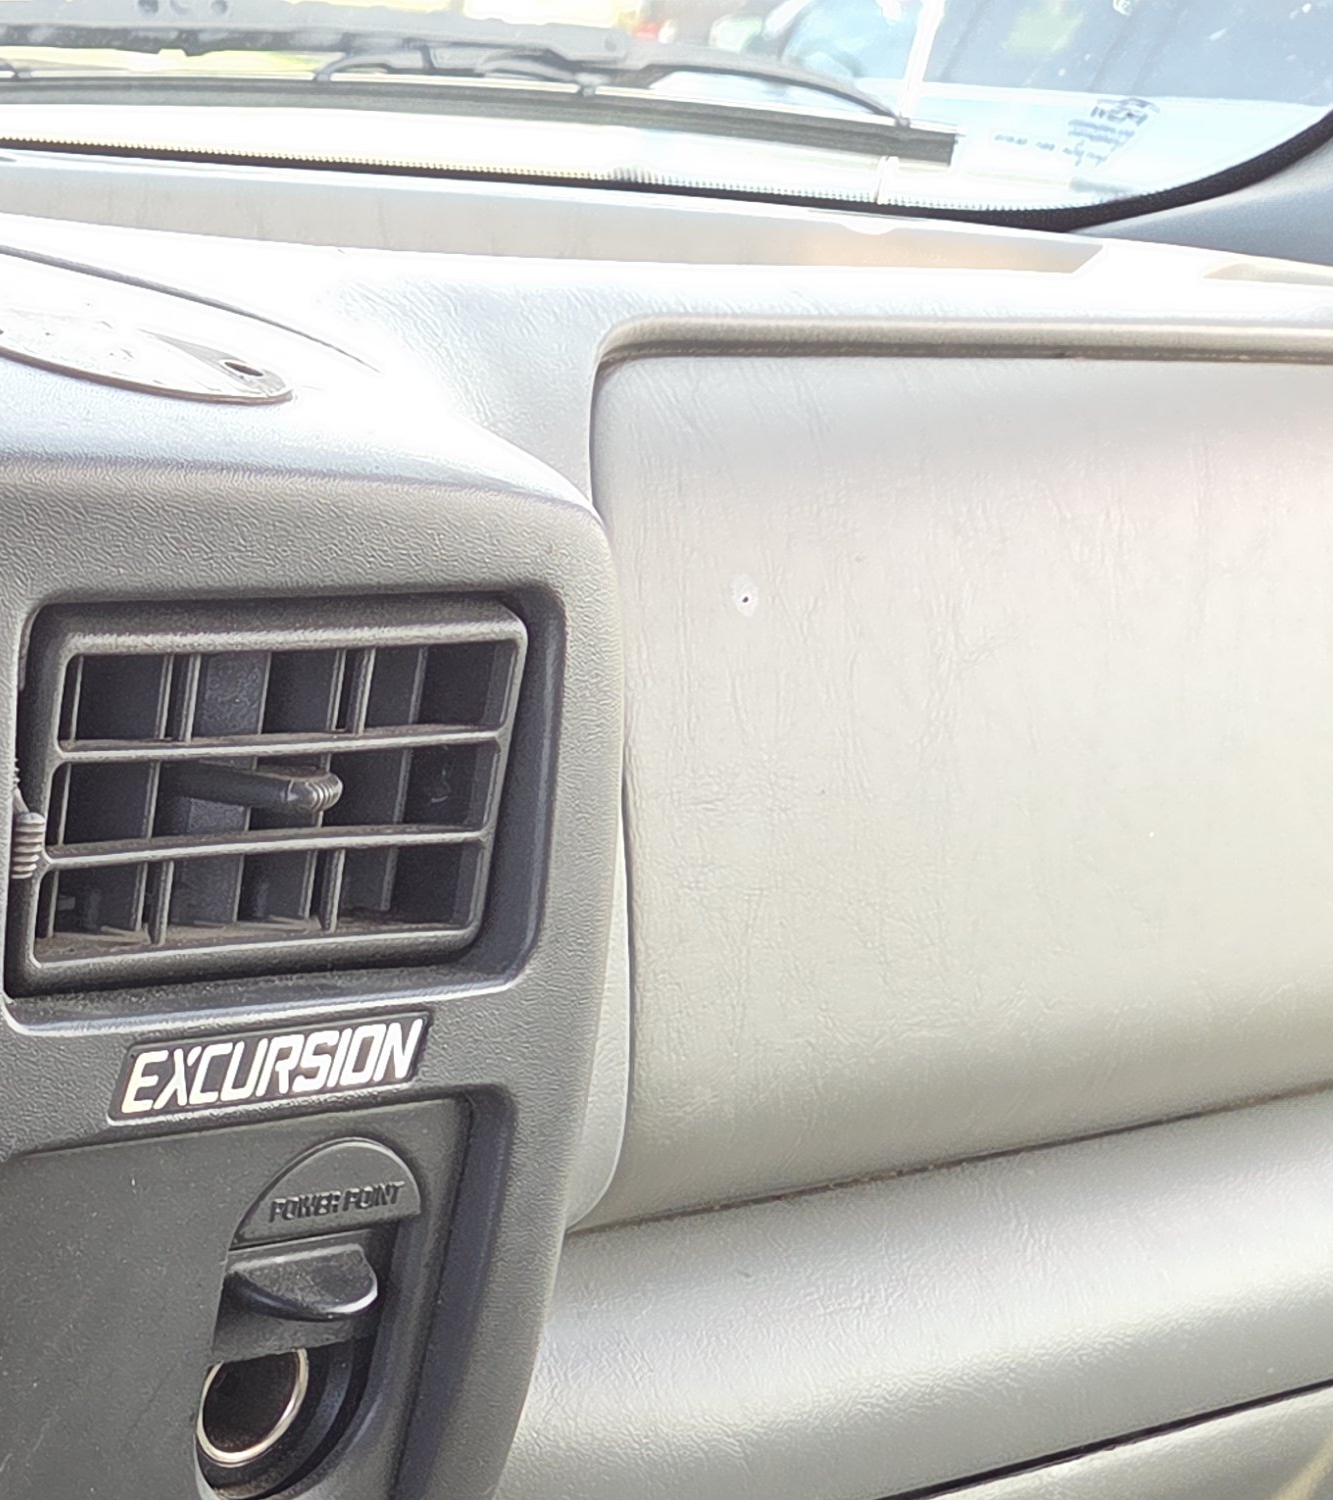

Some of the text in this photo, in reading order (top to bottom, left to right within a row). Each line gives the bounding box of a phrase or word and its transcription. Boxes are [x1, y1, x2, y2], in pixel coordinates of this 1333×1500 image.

[121, 1018, 424, 1114] EXCURSION
[268, 1181, 406, 1223] POWER POINT
